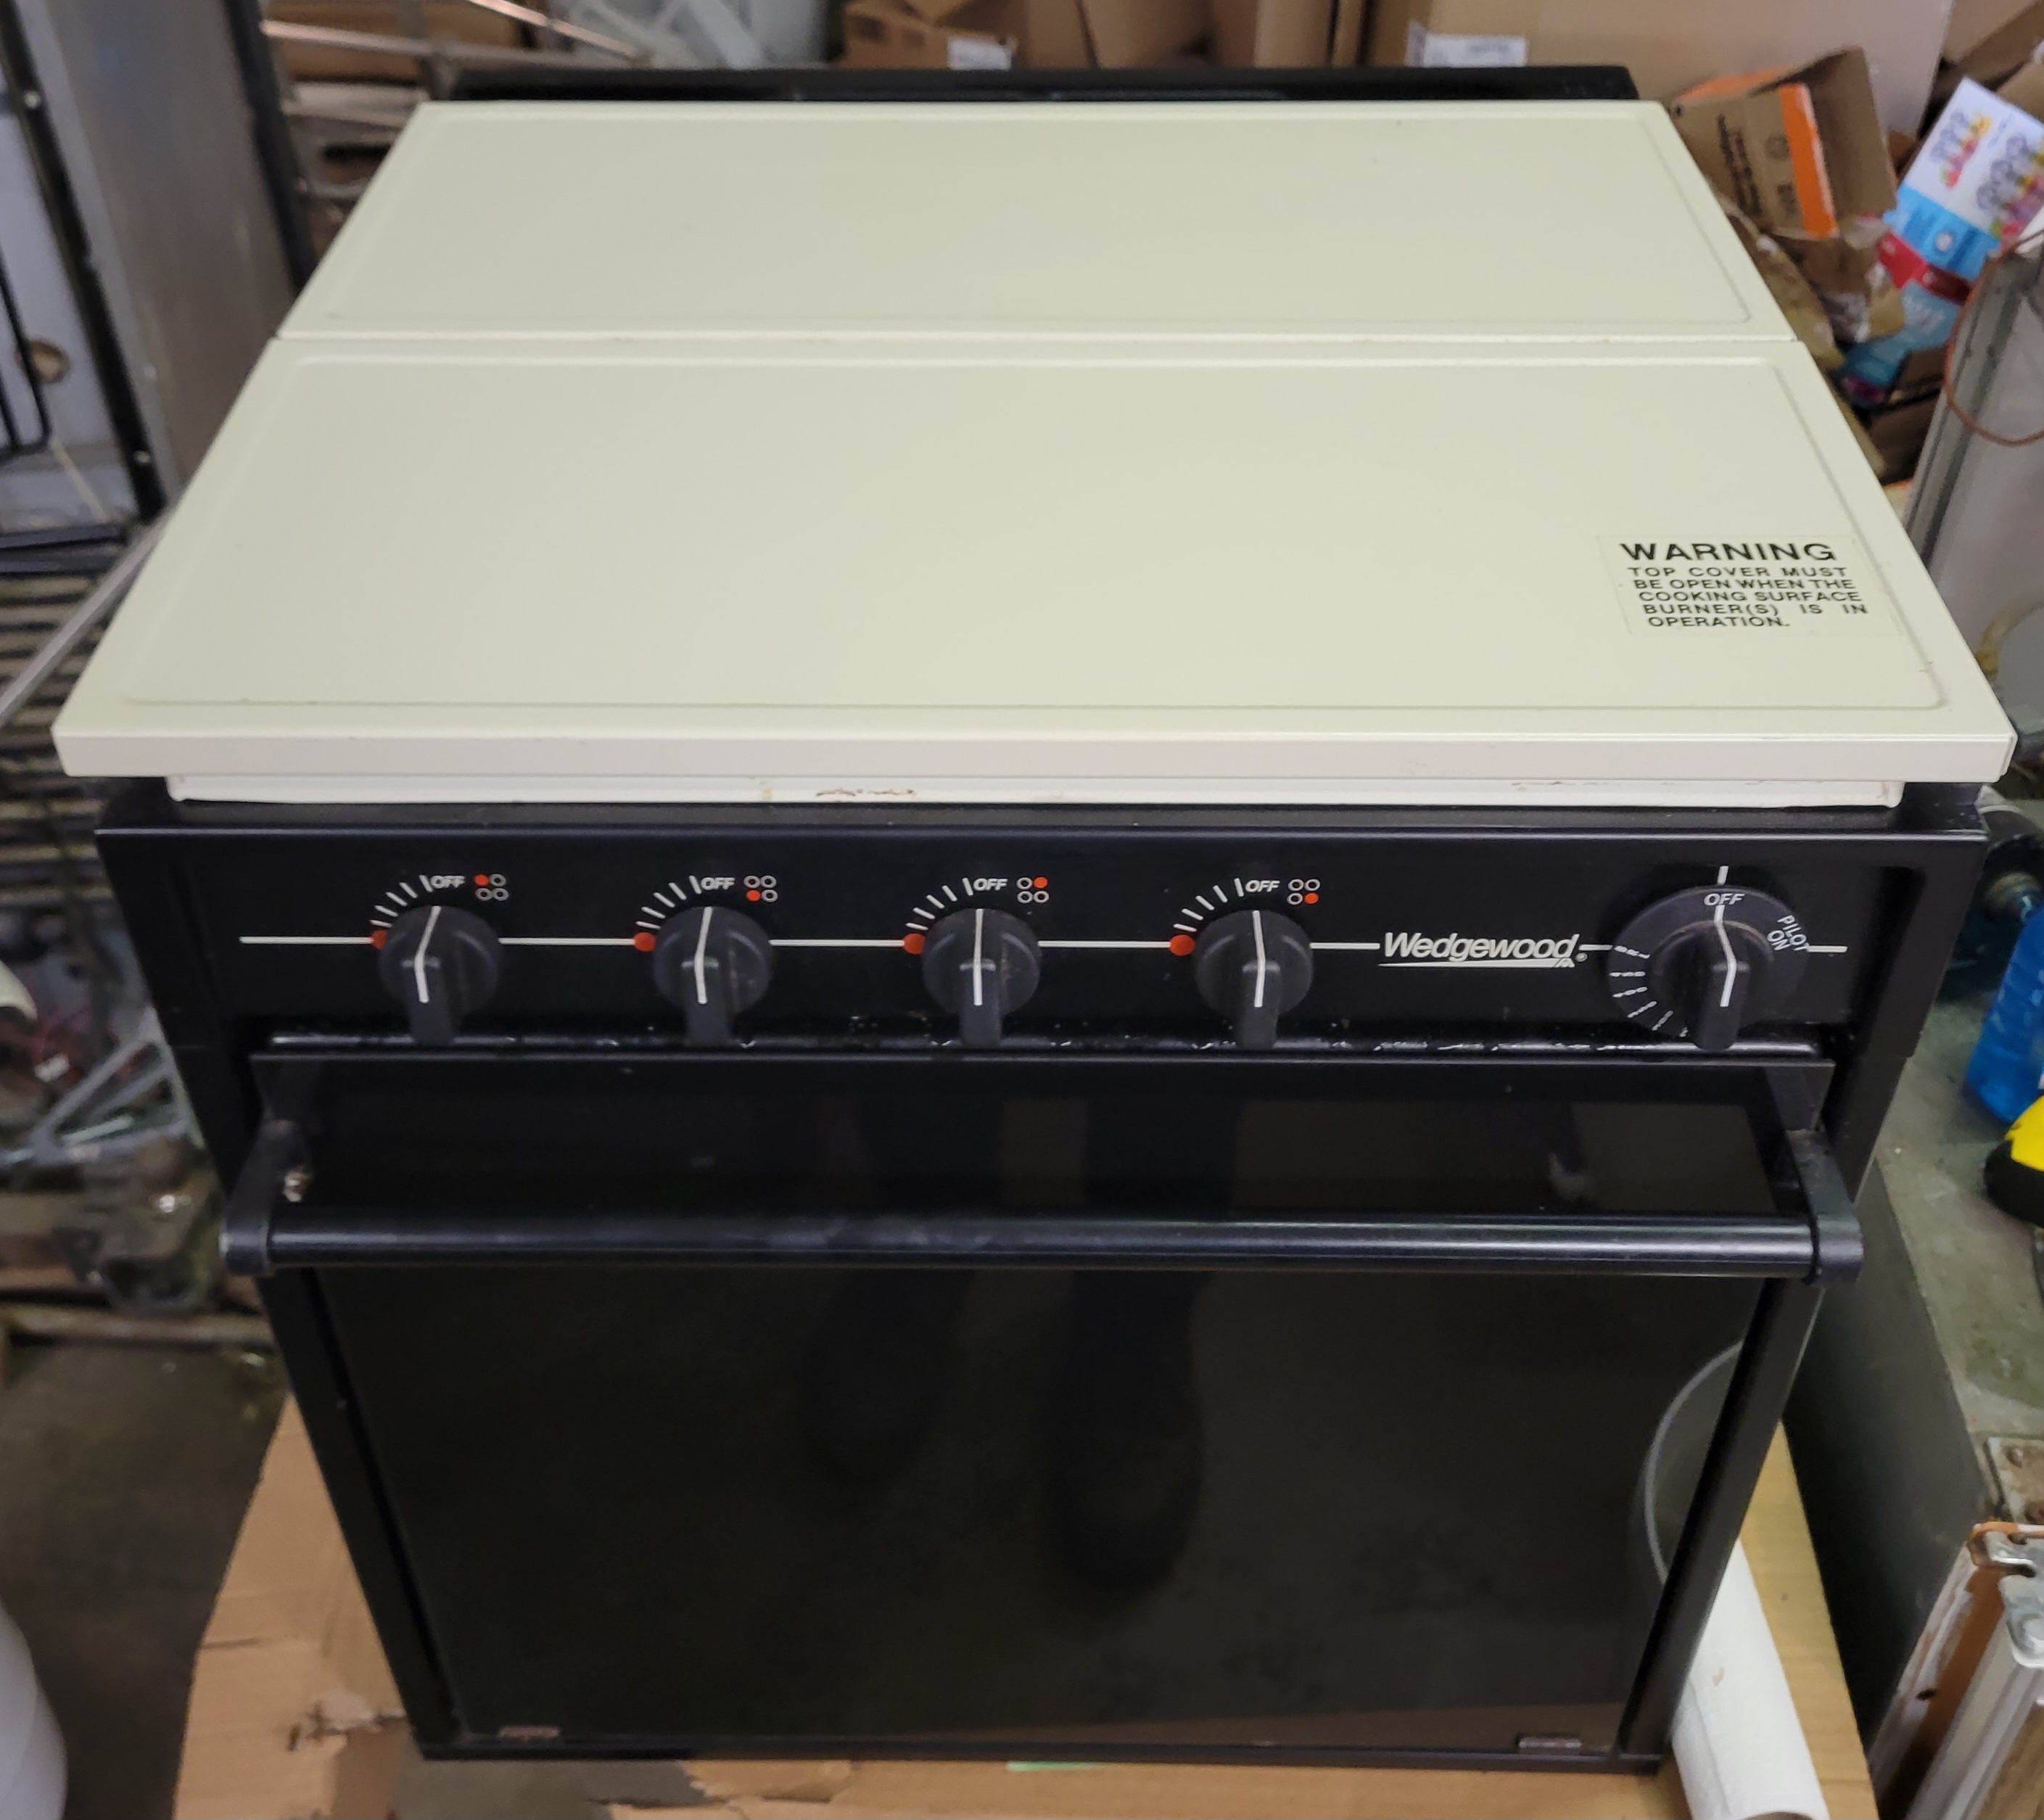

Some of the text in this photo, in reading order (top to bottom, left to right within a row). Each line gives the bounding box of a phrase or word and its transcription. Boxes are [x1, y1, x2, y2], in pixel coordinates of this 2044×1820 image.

[1620, 543, 1837, 561] WARNING
[1628, 567, 1847, 577] TOP COVER MUST
[1633, 580, 1857, 590] BE OPEN WHEN THE
[1639, 591, 1863, 602] COOKING SURFACE
[1644, 604, 1869, 616] BURNER(S) IS IN
[1648, 616, 1791, 627] OPERATION.
[431, 875, 465, 889] OFF
[701, 876, 735, 890] OFF
[973, 878, 1007, 891] OFF
[1245, 879, 1279, 893] OFF
[1704, 893, 1745, 905] OFF
[1777, 915, 1810, 951] PILOT
[1385, 932, 1580, 962] Wedgewood
[1767, 930, 1791, 951] ON
